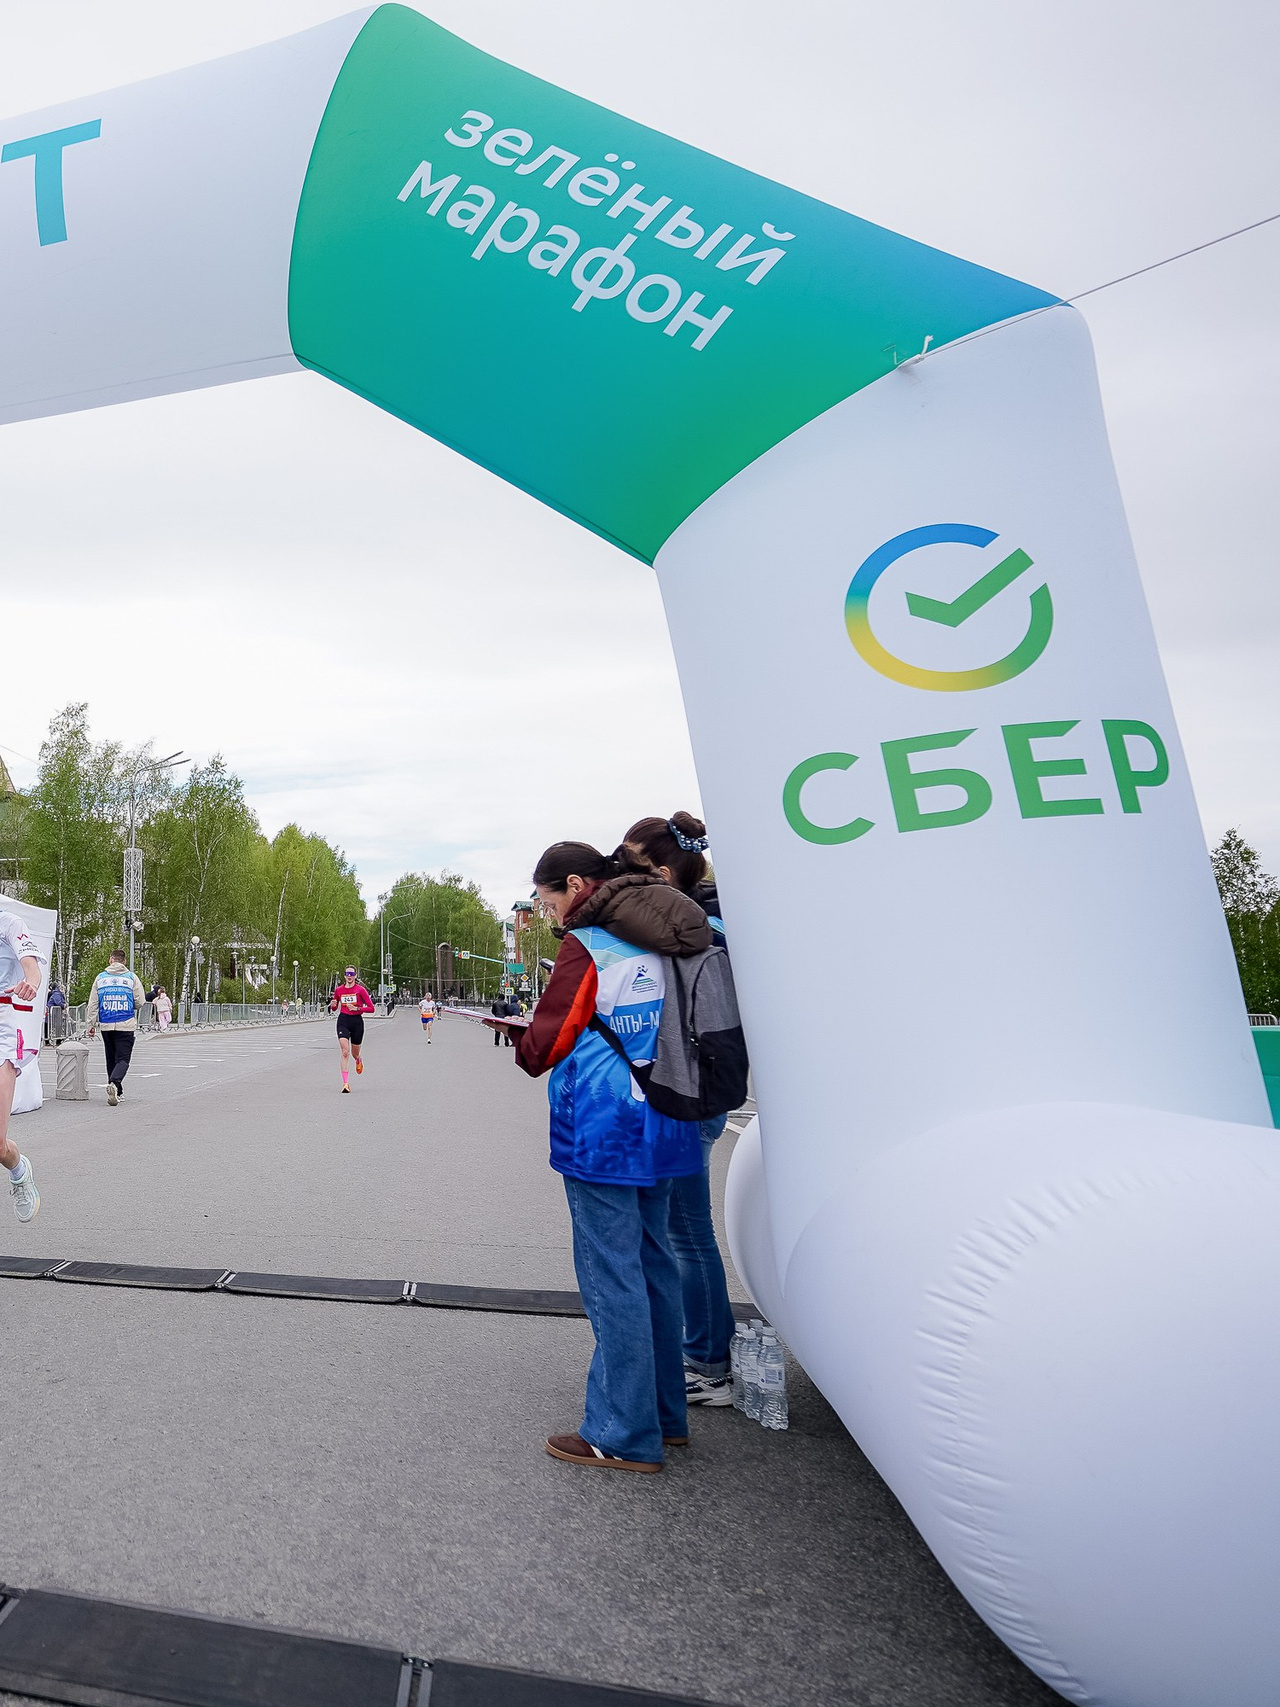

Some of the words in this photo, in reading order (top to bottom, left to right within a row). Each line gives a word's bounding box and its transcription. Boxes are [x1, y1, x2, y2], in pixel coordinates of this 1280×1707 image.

[396, 160, 734, 352] марафон
[444, 110, 797, 286] зелёный
[783, 719, 1169, 845] СБЕР
[102, 1001, 129, 1012] СУДЬЯ
[610, 1010, 660, 1034] АНТЫ-М
